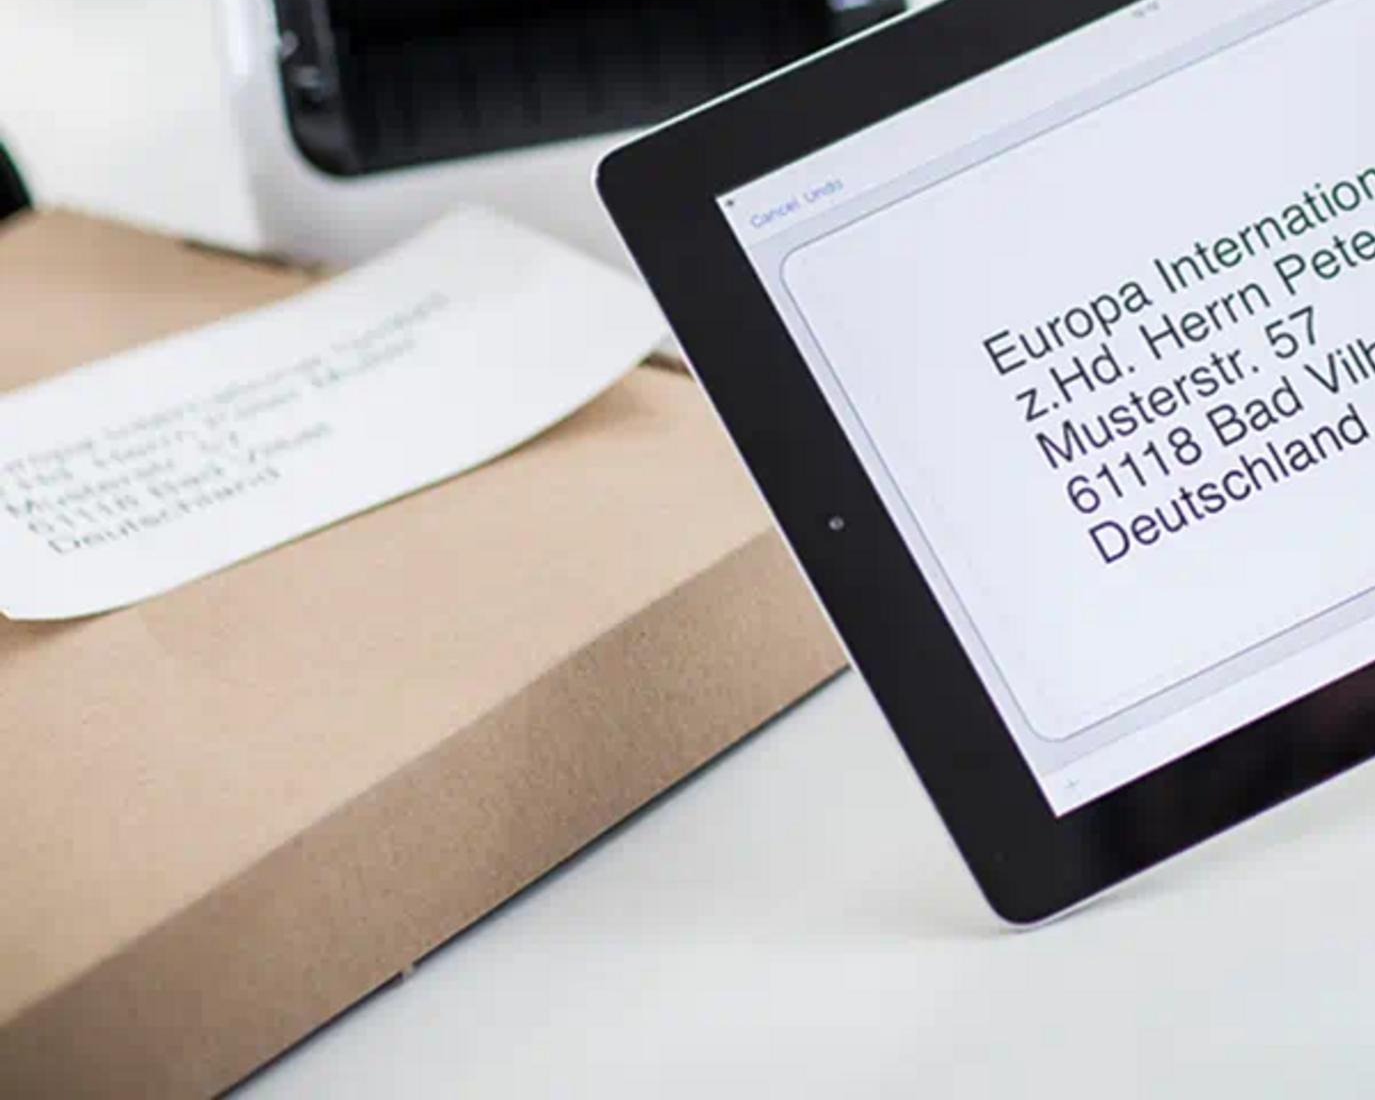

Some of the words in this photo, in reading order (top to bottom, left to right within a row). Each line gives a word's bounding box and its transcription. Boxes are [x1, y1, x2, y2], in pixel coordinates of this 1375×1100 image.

[984, 280, 1152, 376] Europa
[1015, 343, 1136, 422] z.Hd.
[1139, 282, 1270, 361] Herrn
[1036, 340, 1259, 470] Musterstr.
[1264, 304, 1319, 362] 57
[1066, 427, 1202, 515] 61118
[1207, 376, 1304, 448] Bad
[1088, 404, 1371, 564] Deutschland
